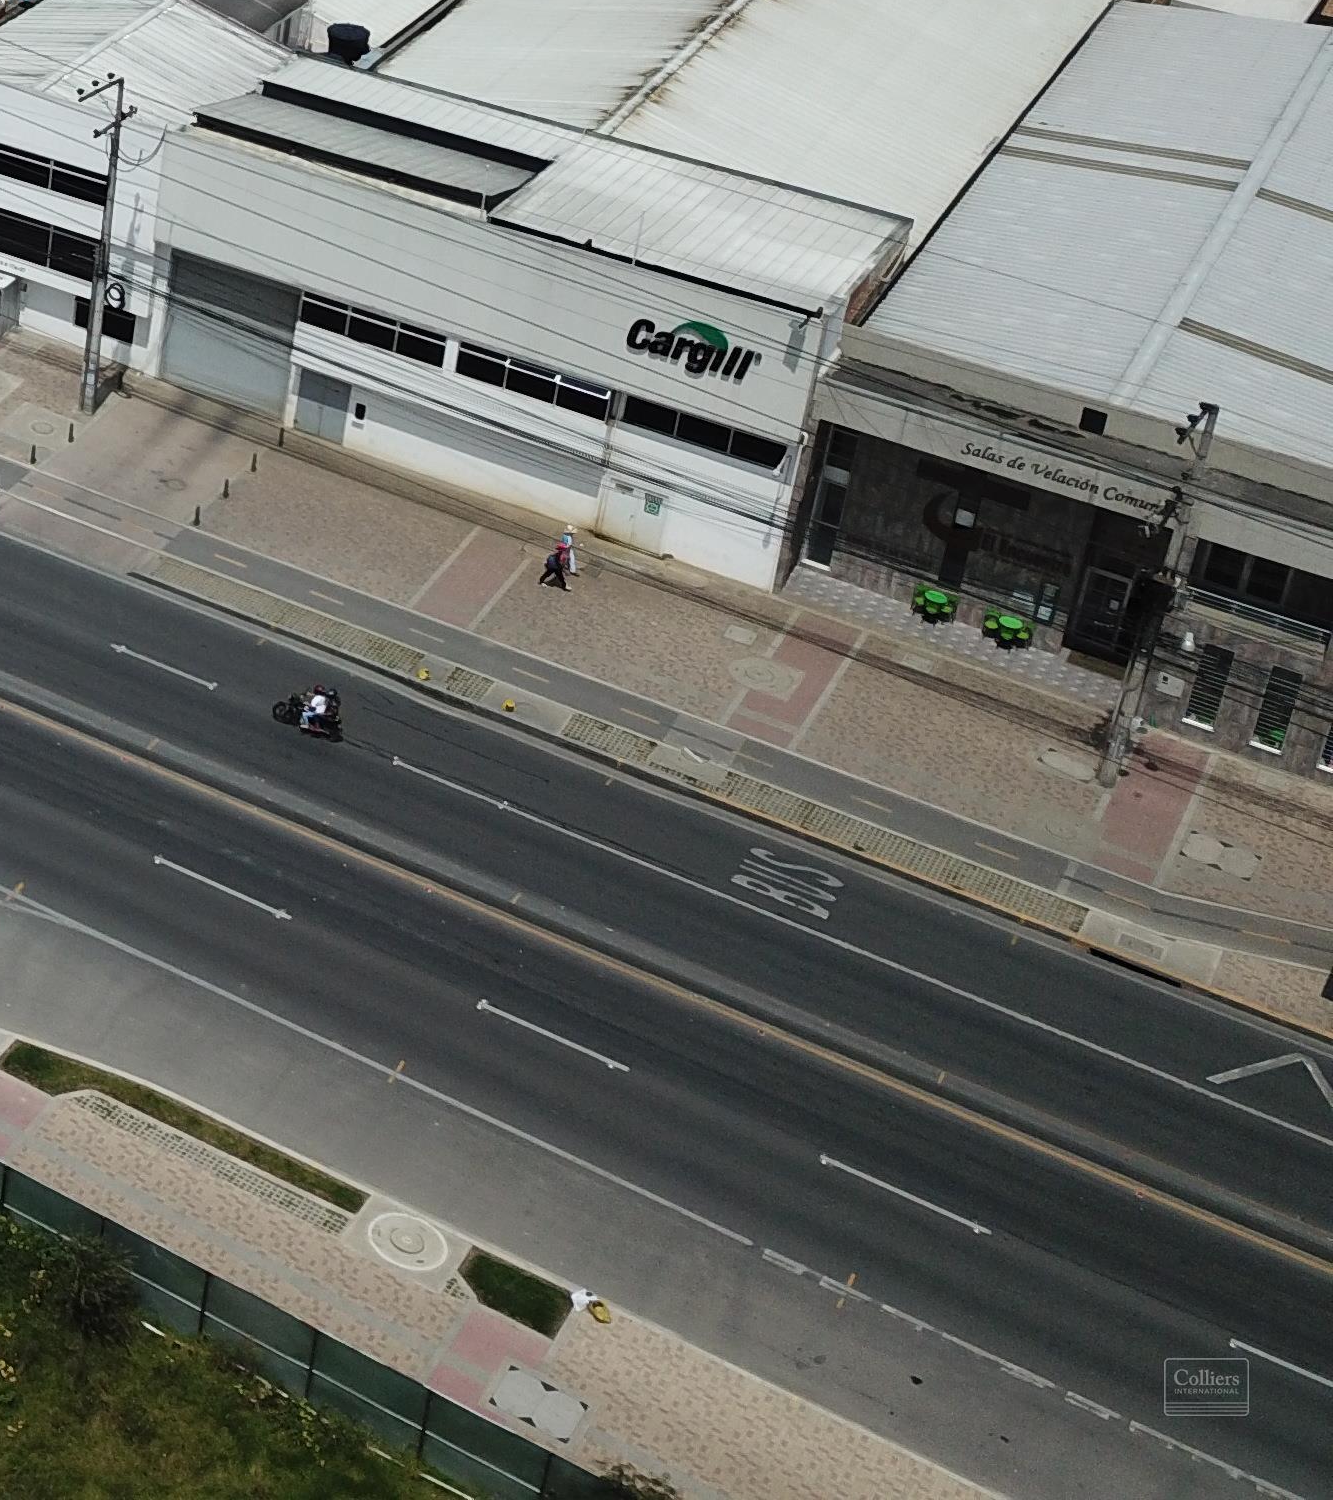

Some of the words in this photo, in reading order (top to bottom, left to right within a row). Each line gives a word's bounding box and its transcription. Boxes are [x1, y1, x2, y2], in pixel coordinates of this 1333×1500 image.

[626, 318, 756, 380] Cargill
[960, 442, 1005, 465] Salas
[1006, 455, 1026, 472] de
[1030, 462, 1100, 495] Velación
[730, 847, 845, 920] BUS
